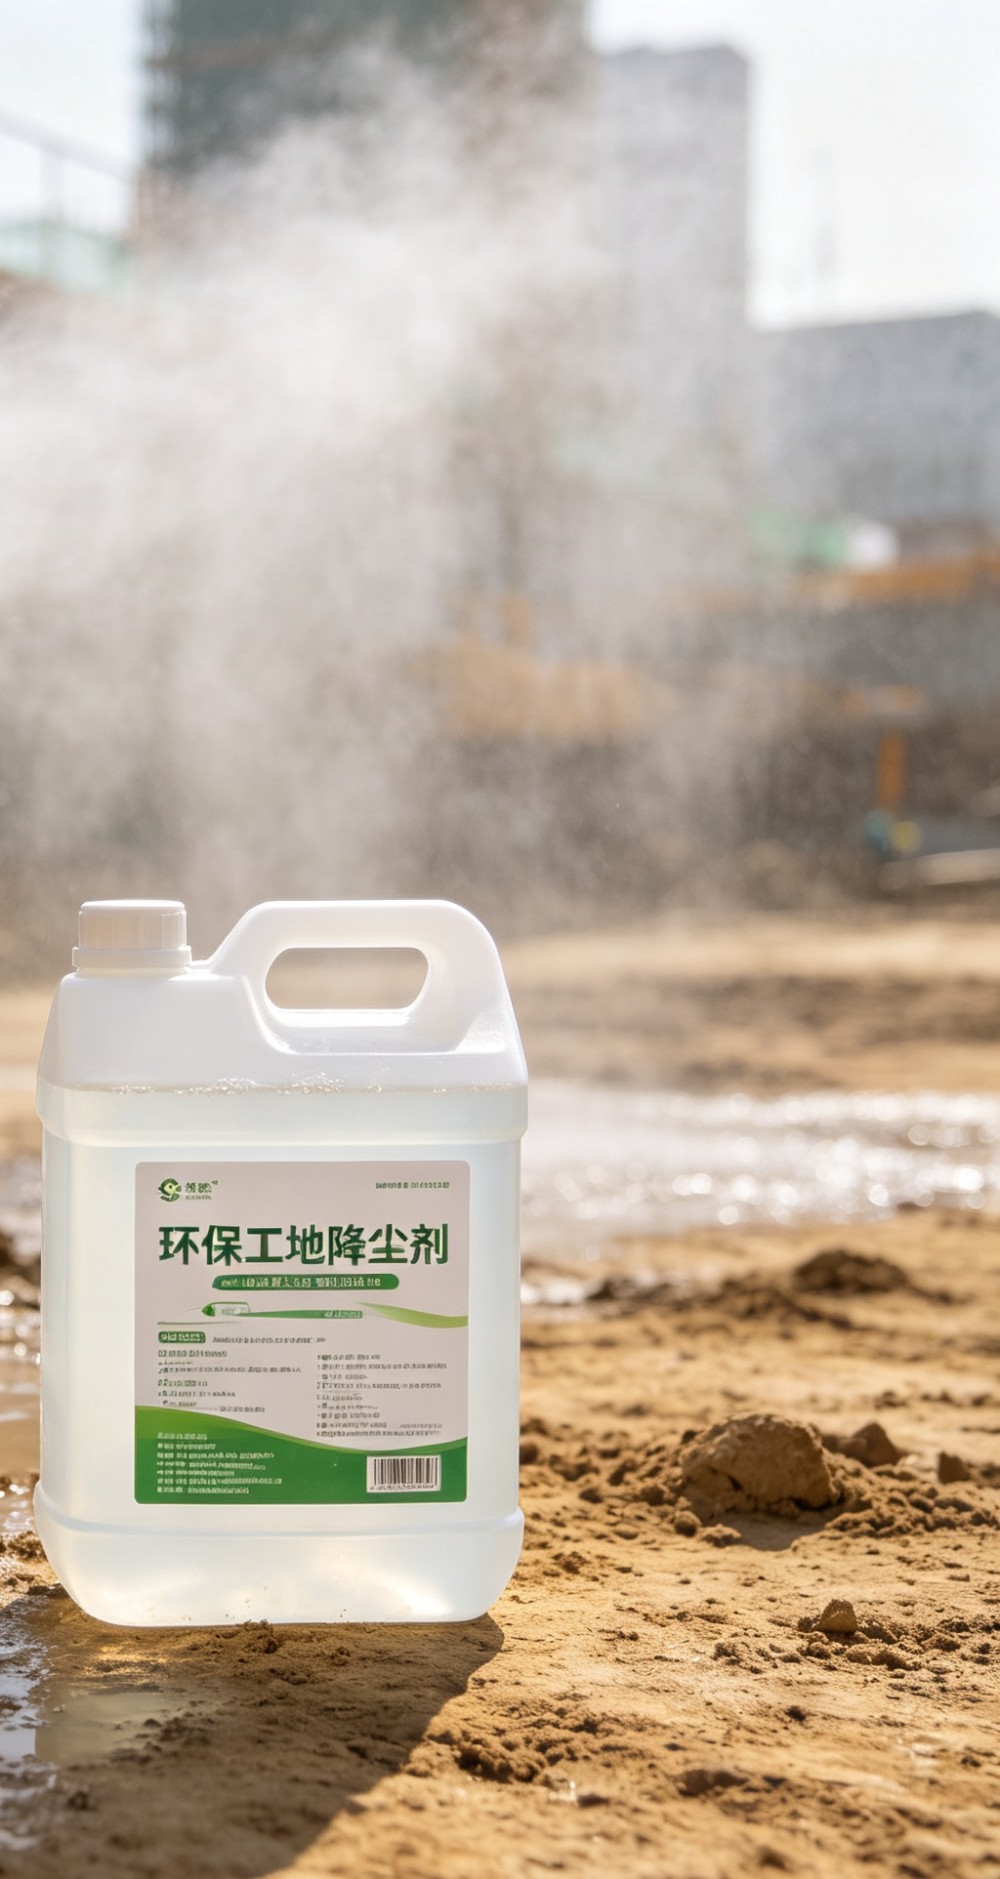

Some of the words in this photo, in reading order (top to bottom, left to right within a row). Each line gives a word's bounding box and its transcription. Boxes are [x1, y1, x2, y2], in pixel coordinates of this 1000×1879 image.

[158, 1223, 449, 1266] 环保工地降尘剂
